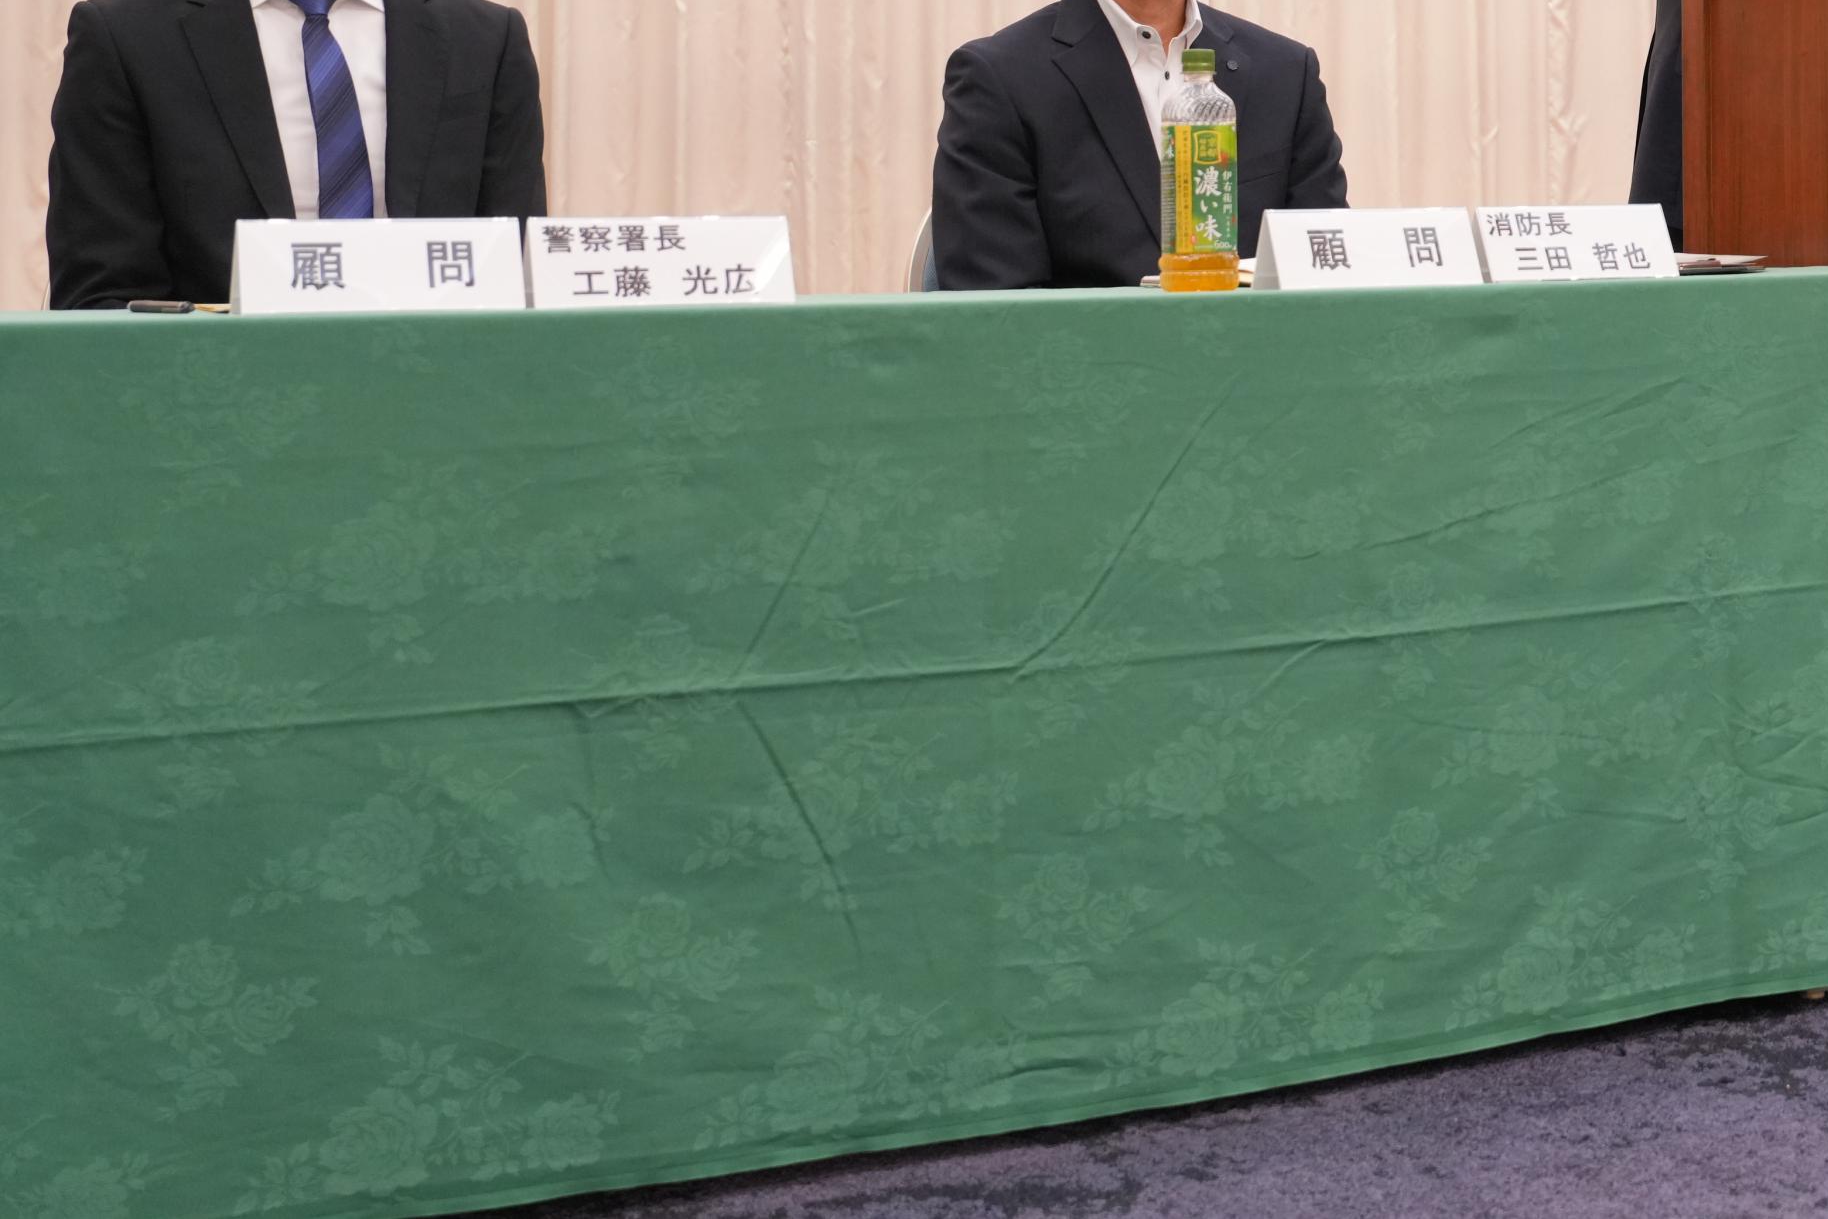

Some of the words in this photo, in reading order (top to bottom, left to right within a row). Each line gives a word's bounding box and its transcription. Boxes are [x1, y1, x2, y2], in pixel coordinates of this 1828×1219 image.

[1194, 166, 1223, 241] 濃い味
[541, 224, 687, 254] 警察署長
[1486, 212, 1573, 237] 消防長
[1514, 245, 1573, 271] 三田
[1591, 241, 1652, 271] 哲也
[572, 265, 652, 298] 工藤
[681, 263, 757, 296] 光広
